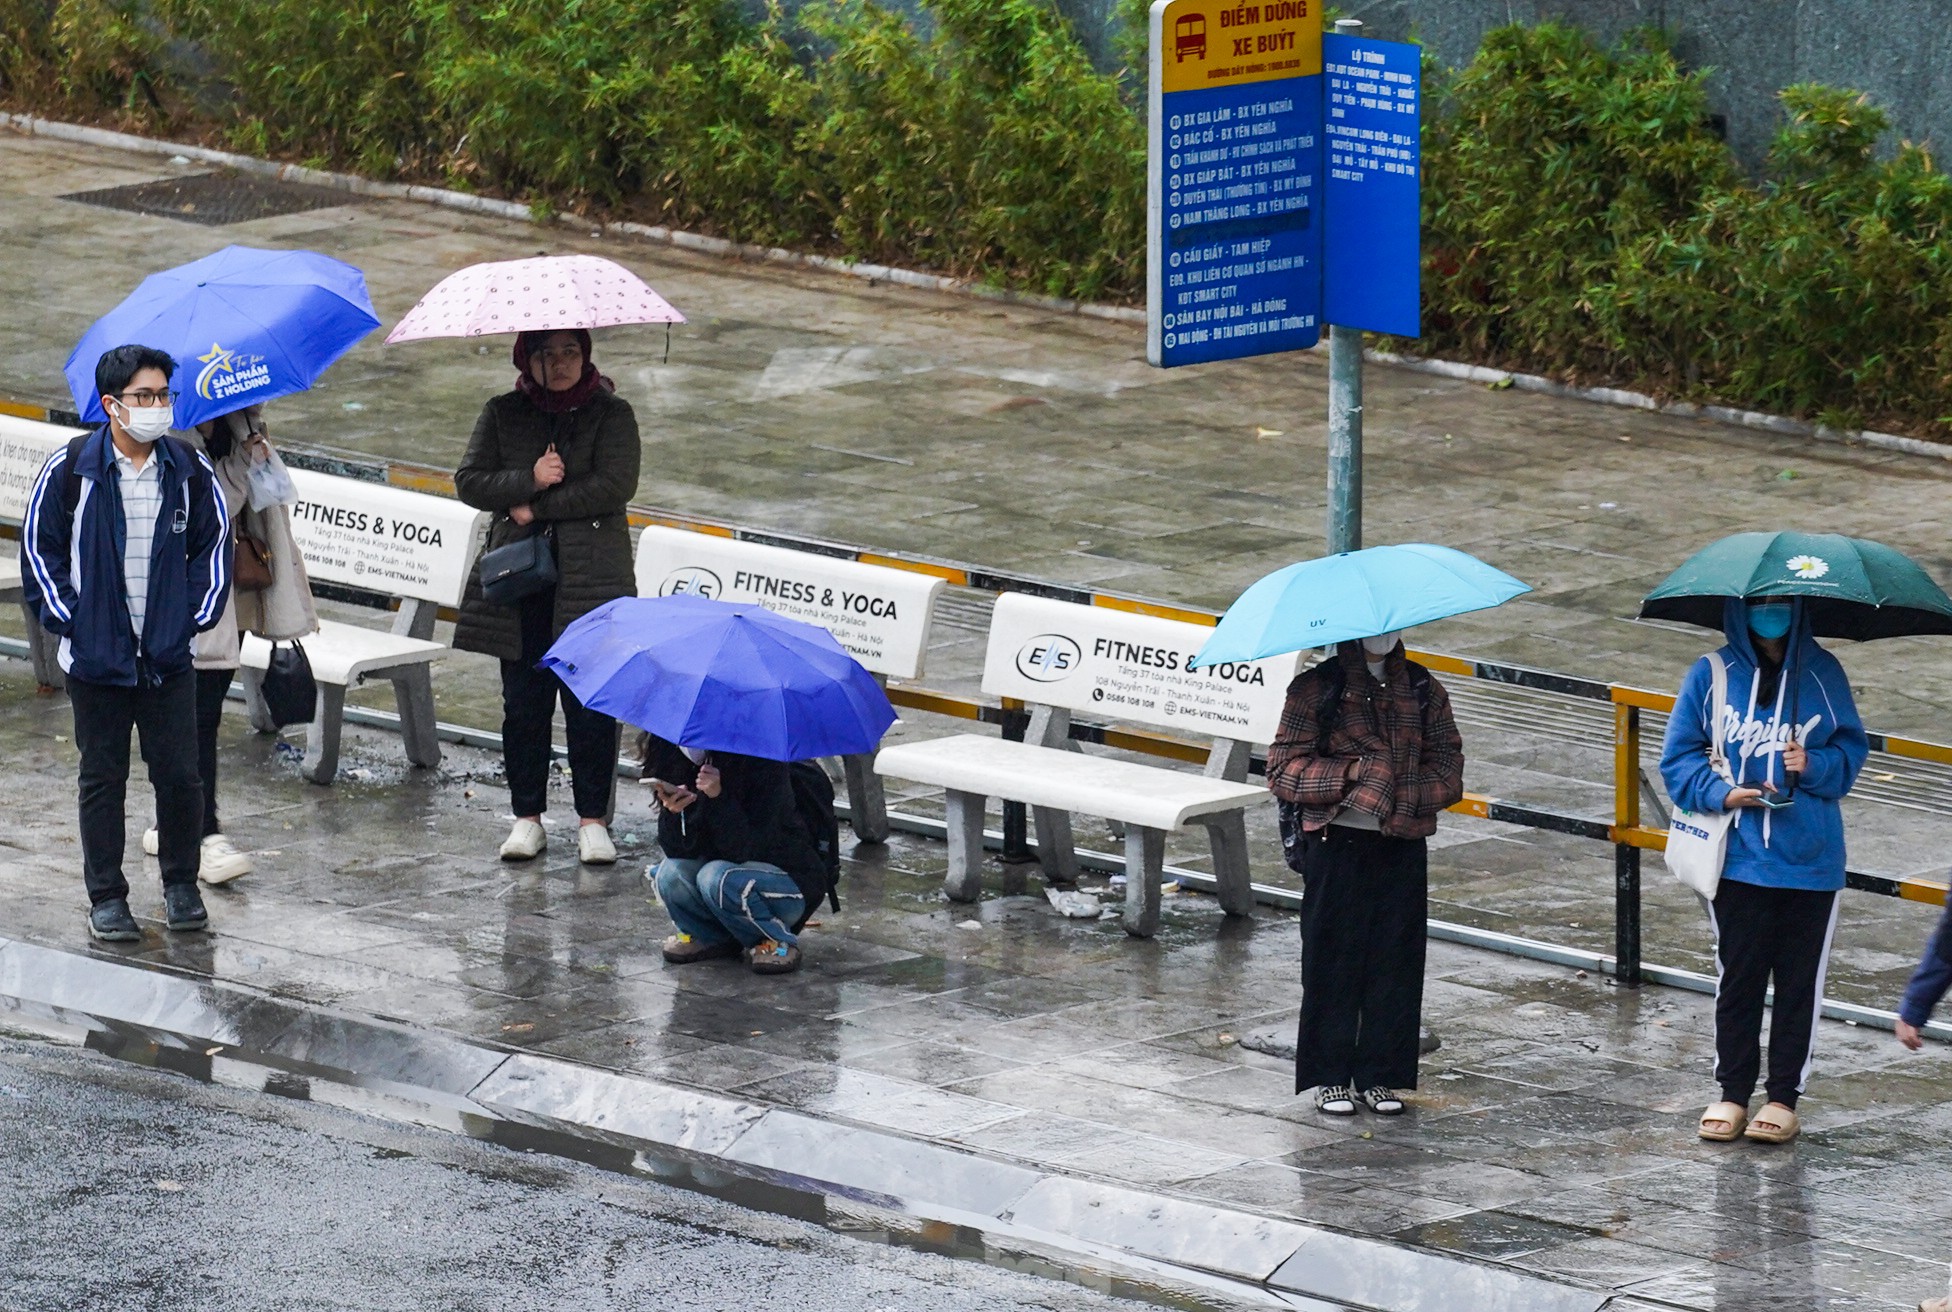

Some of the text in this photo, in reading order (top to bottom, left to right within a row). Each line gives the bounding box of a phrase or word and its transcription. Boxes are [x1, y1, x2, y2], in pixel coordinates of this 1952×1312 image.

[1220, 0, 1307, 28] ĐIỂM DỪNG
[1233, 28, 1295, 57] XE BUÝT
[215, 375, 271, 398] Z HOLDING
[293, 500, 443, 548] FITNESS & YOGA
[334, 530, 342, 540] 37
[343, 533, 355, 543] tòa
[357, 535, 371, 546] nhà
[372, 540, 389, 552] King
[391, 543, 414, 555] Palace
[304, 552, 428, 585] 0586 108 108 EMS-VIETNAM.VN
[357, 549, 379, 562] Thanh
[381, 553, 400, 566] Xuân
[406, 559, 415, 569] Hà
[417, 561, 430, 573] Nội
[734, 571, 898, 620] FITNESS & YOGA
[778, 602, 788, 612] 37
[789, 604, 801, 614] tòa
[804, 608, 819, 618] nhà
[821, 610, 839, 623] King
[840, 614, 867, 627] Palace
[1310, 618, 1327, 628] UV
[857, 633, 868, 642] Hà
[871, 635, 884, 645] Nội
[1093, 638, 1264, 687] FITNESS & YOGA
[1096, 676, 1108, 686] 108
[1167, 689, 1192, 701] Thanh
[1195, 695, 1215, 705] Xuân
[1223, 699, 1233, 709] Hà
[1237, 702, 1250, 712] Nội
[1140, 669, 1150, 678] 37
[1152, 672, 1164, 681] tòa
[1167, 675, 1182, 685] nhà
[1184, 678, 1203, 690] King
[1205, 681, 1232, 693] Palace
[1106, 693, 1249, 725] 0586 108 108 EMS-VIETNAM.VN
